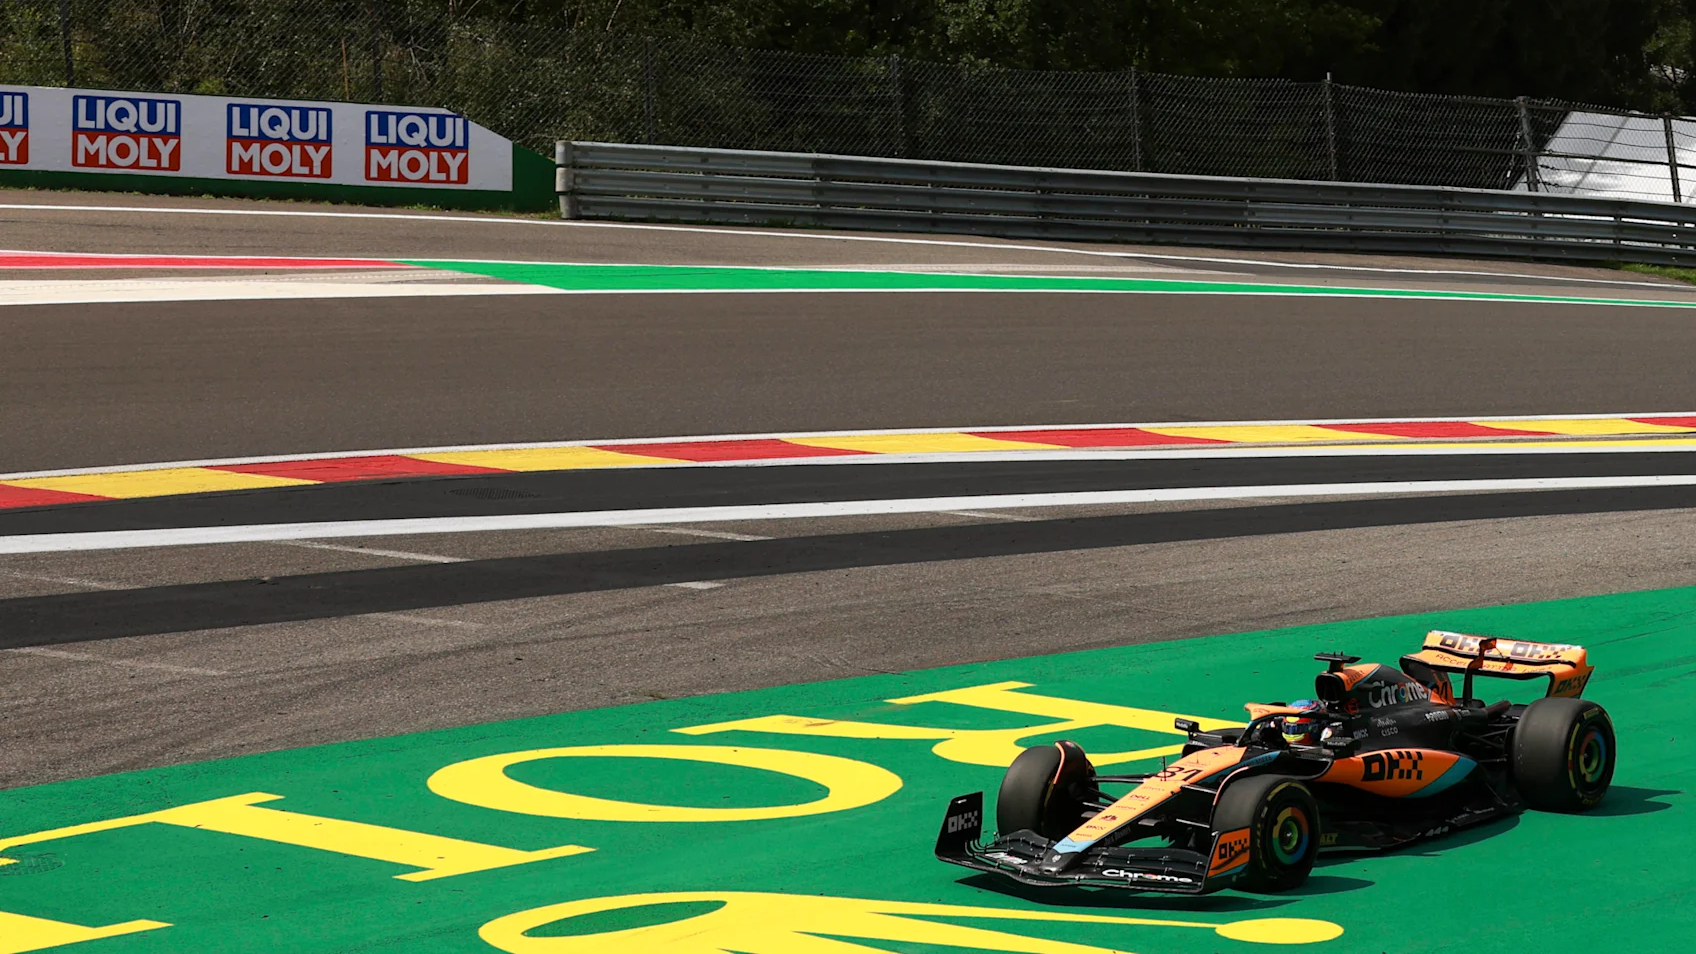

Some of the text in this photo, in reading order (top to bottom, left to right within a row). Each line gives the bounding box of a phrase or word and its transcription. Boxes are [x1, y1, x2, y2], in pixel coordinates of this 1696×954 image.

[78, 98, 177, 134] LIQUI
[231, 105, 329, 142] LIQUI
[369, 113, 465, 148] LIQUI
[77, 134, 181, 169] MOLY
[231, 142, 331, 175] MOLY
[369, 148, 468, 181] MOLY
[1369, 680, 1429, 709] Chrome
[1361, 751, 1423, 782] OKX
[948, 810, 979, 834] OKX
[1219, 837, 1249, 860] OKX
[1101, 867, 1194, 884] Chrome
